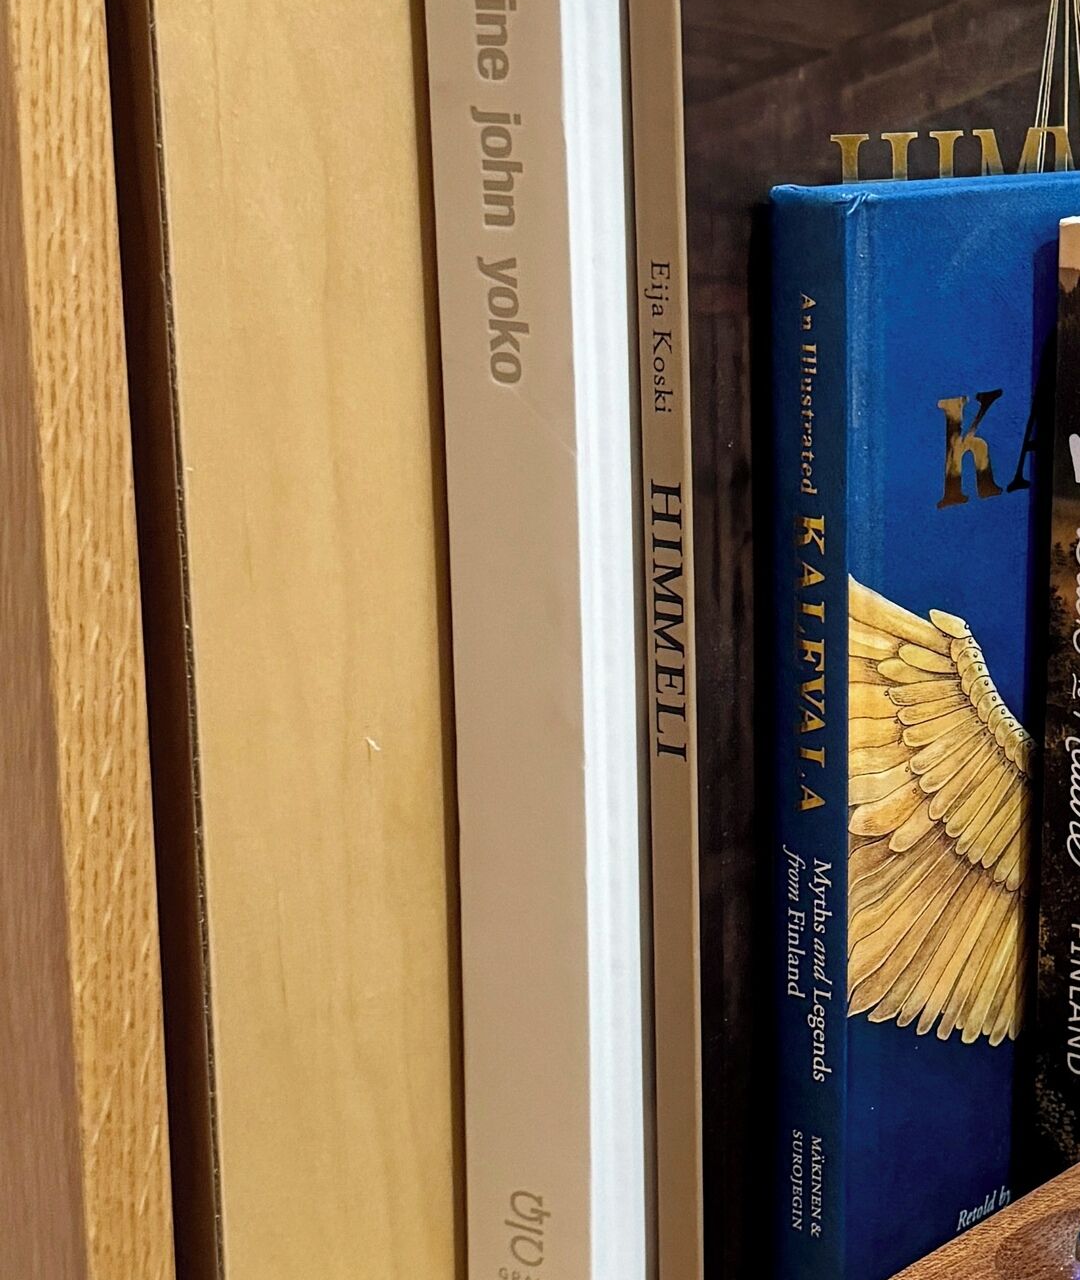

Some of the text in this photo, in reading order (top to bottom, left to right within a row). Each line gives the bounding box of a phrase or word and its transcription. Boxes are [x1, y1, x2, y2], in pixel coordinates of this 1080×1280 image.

[470, 105, 523, 227] john
[476, 255, 530, 385] yoko
[644, 261, 674, 413] Eija Koski
[650, 478, 689, 763] HIMMELI
[797, 293, 826, 812] An Illustrated KALEVALA
[783, 844, 807, 998] from Finland
[807, 857, 833, 1082] Myths and Legends
[790, 1129, 803, 1231] SUROJEGIN
[810, 1135, 825, 1238] MÄKINEN &
